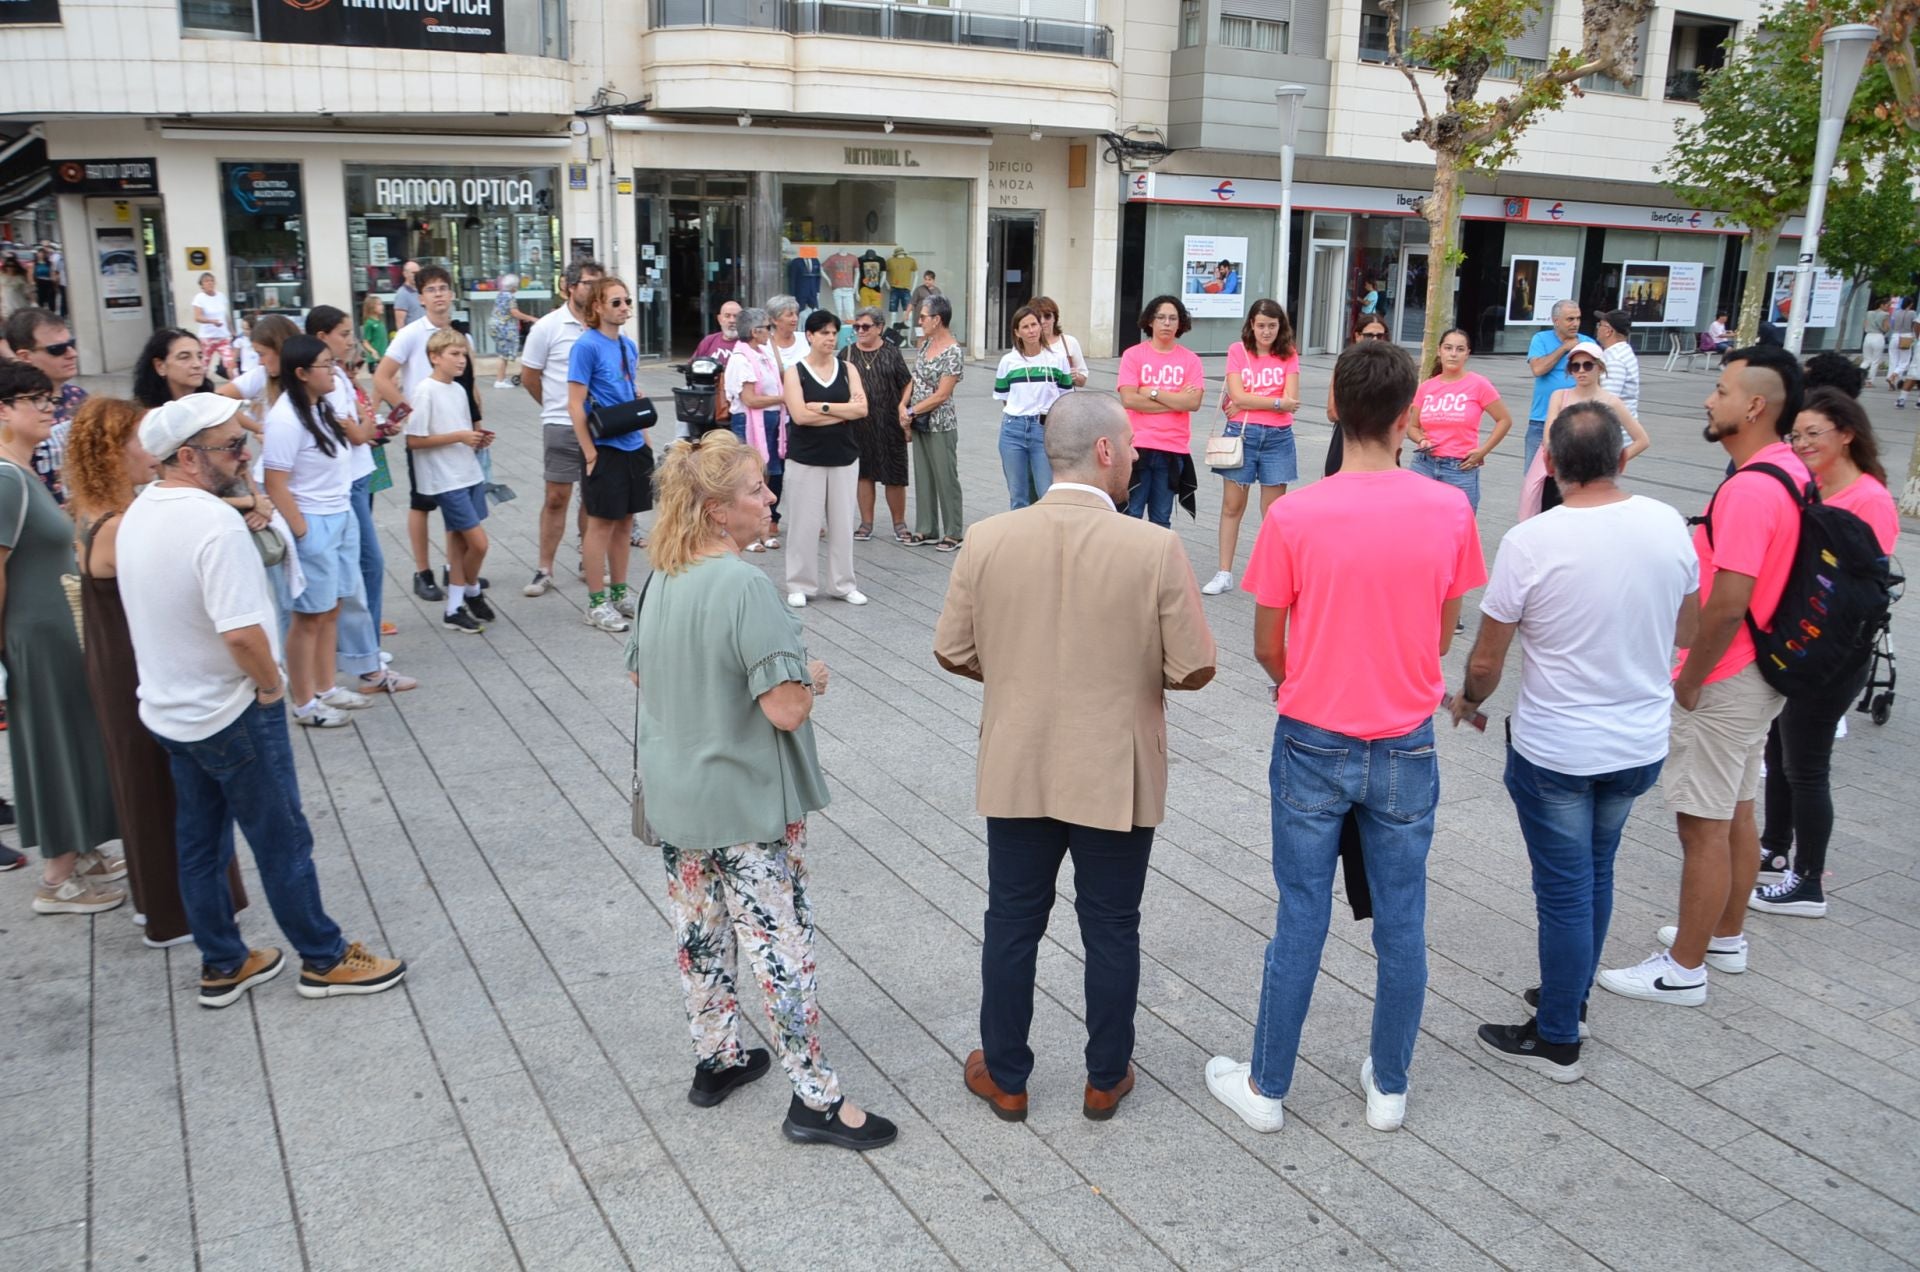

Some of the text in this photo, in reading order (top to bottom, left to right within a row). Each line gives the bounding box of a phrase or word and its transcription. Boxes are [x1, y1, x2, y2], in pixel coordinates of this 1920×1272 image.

[988, 161, 1033, 173] DIFICIO
[376, 178, 533, 206] RAMON OPTICA
[1000, 179, 1034, 191] MOZA
[1651, 211, 1684, 225] iberCaja
[1141, 363, 1184, 385] CJCC
